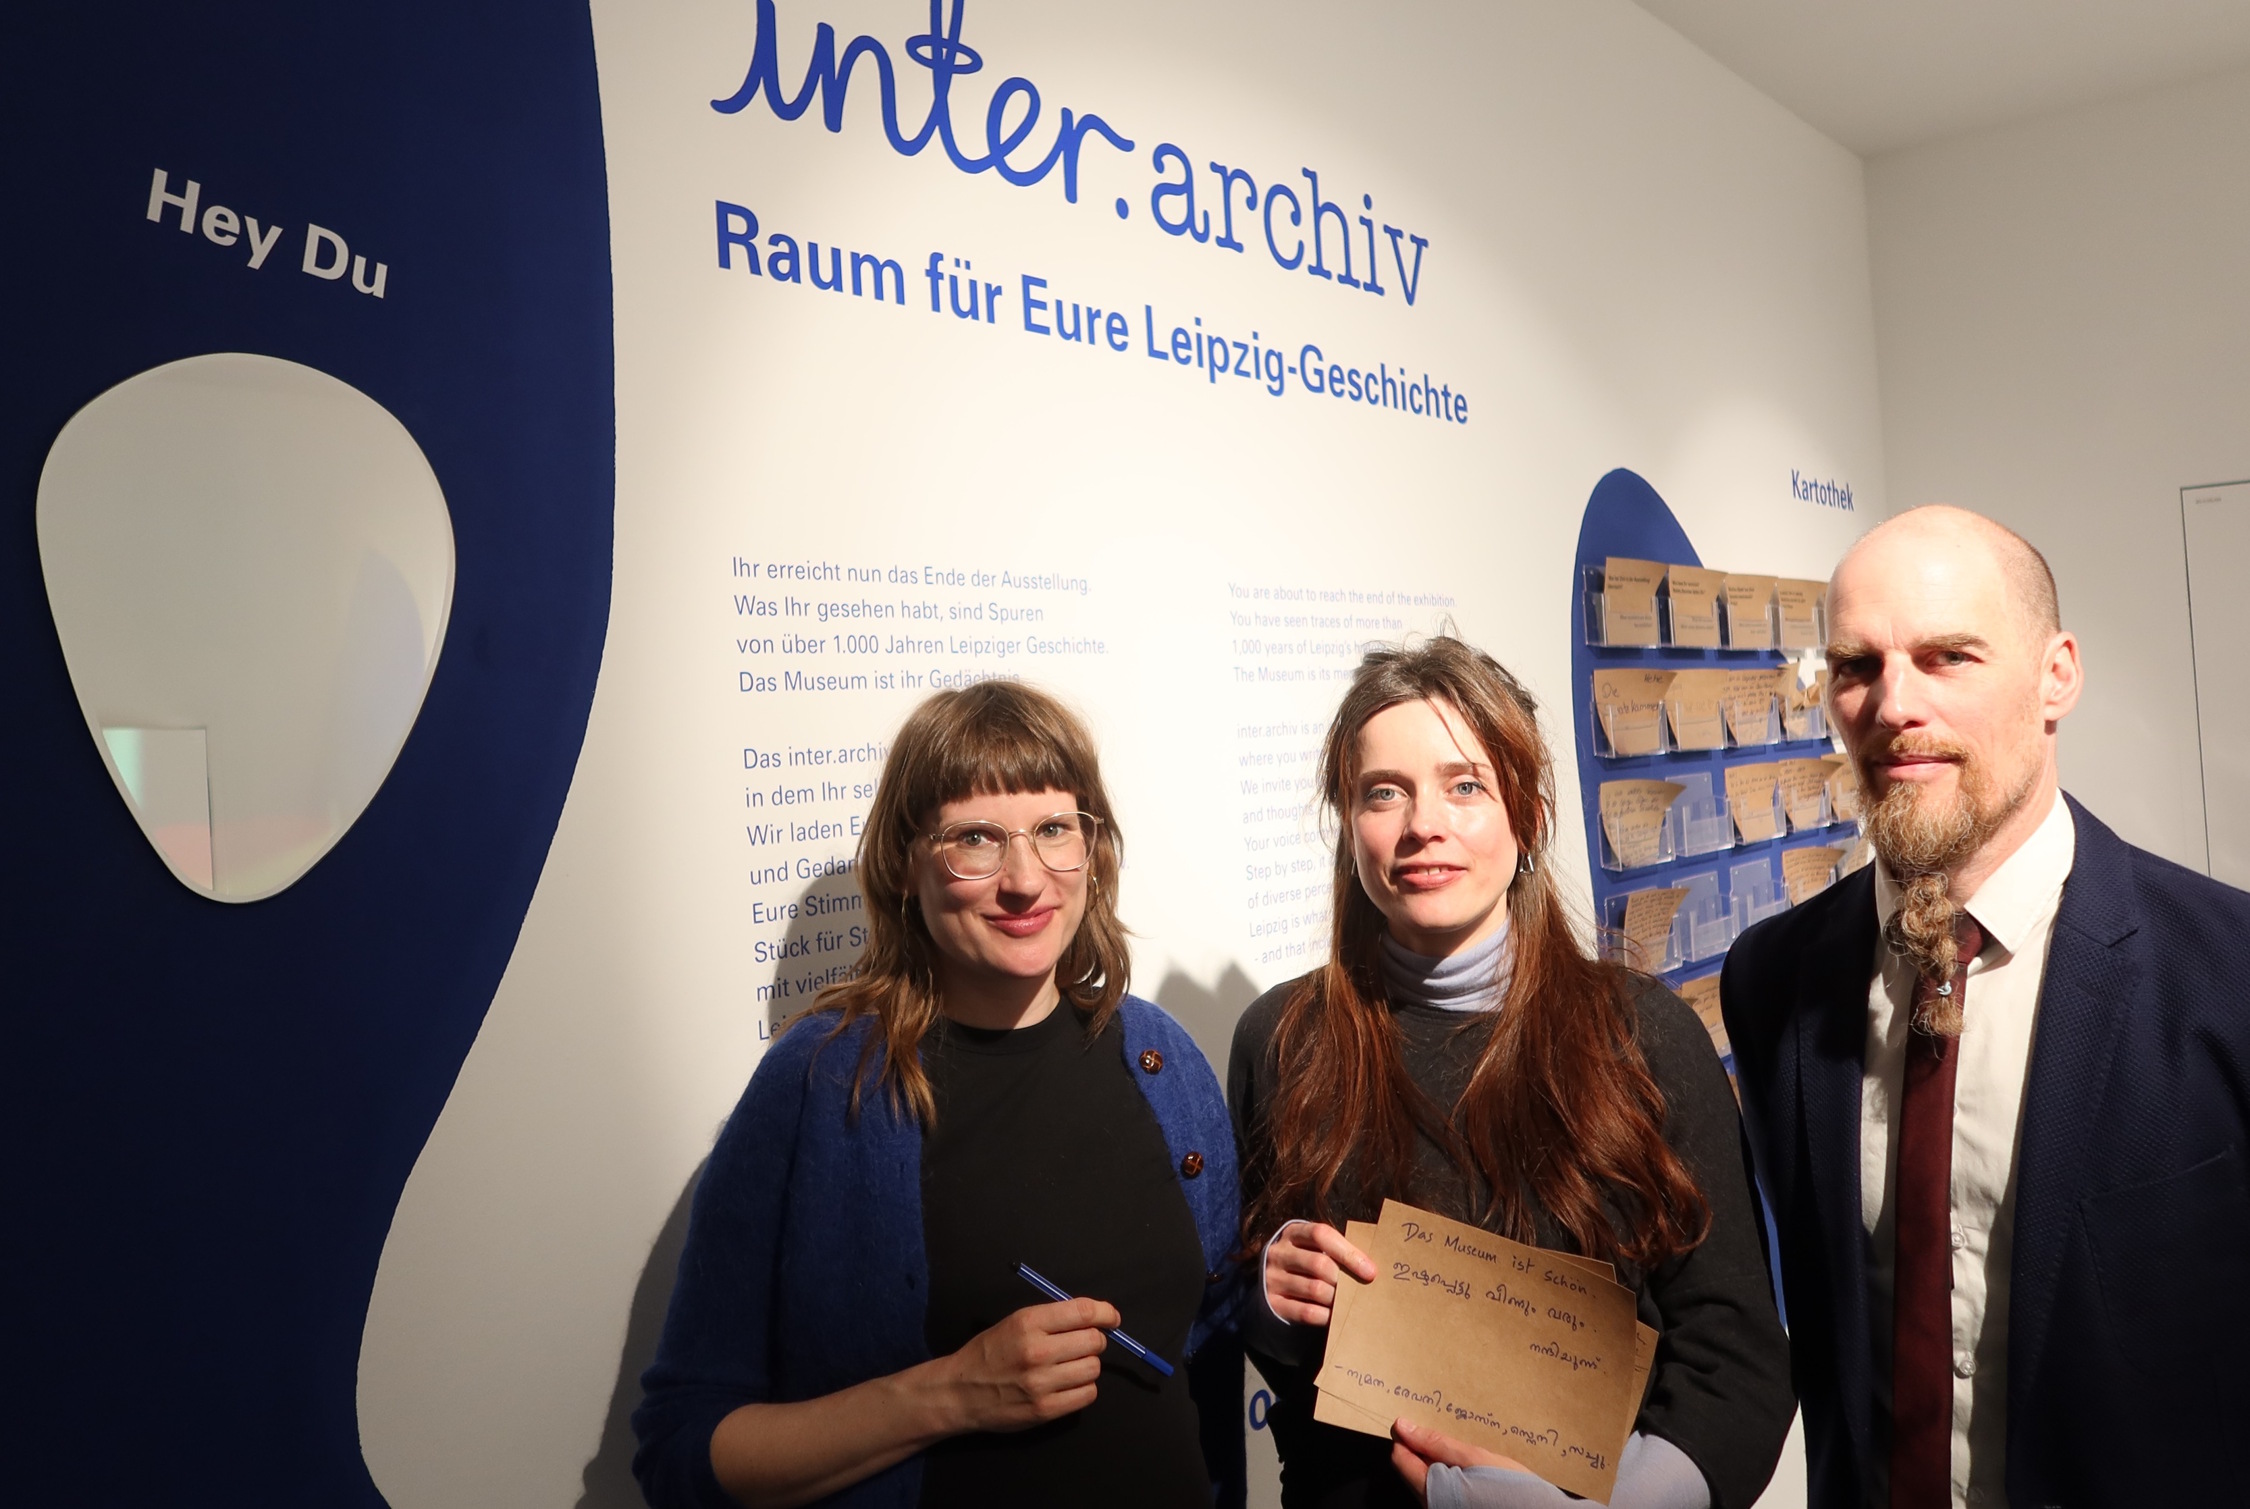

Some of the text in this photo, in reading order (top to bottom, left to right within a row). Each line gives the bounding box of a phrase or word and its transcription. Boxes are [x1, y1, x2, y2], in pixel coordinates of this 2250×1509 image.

[146, 167, 389, 299] Hey Du
[715, 200, 1468, 425] Raum für Eure Leipzig-Geschichte
[1791, 469, 1855, 511] Kartothek
[732, 556, 1093, 595] Ihr erreicht nun das Ende der Ausstellung.
[1228, 582, 1457, 608] You are about to reach the end of the exhibition.
[734, 595, 1044, 625] Was Ihr gesehen habt, sind Spuren
[1229, 611, 1402, 630] You have seen traces of more than
[736, 633, 1109, 658] von über 1.000 Jahren Leipziger Geschichte.
[1232, 639, 1262, 657] 1,000
[1264, 642, 1294, 657] years
[1296, 639, 1307, 655] of
[739, 672, 777, 692] Das
[785, 671, 868, 691] Museum
[874, 670, 895, 689] ist
[901, 670, 923, 689] ihr
[1233, 667, 1255, 683] The
[1258, 667, 1304, 682] Museum
[1307, 667, 1316, 681] is
[1319, 667, 1331, 681] its
[1301, 720, 1310, 735] is
[744, 747, 782, 769] Das
[1239, 752, 1274, 767] where
[1276, 752, 1296, 767] you
[745, 788, 764, 808] in
[771, 784, 814, 807] dem
[822, 781, 846, 801] Ihr
[1240, 777, 1315, 795] We invite you
[1242, 807, 1263, 824] and
[747, 823, 783, 846] Wir
[791, 819, 842, 842] laden
[1244, 836, 1270, 852] Your
[1273, 831, 1301, 848] voice
[750, 862, 788, 885] und
[1246, 864, 1272, 881] Step
[1275, 860, 1288, 878] by
[1248, 892, 1259, 909] of
[1262, 889, 1302, 906] diverse
[752, 902, 798, 924] Eure
[1249, 917, 1289, 938] Leipzig
[1291, 913, 1300, 929] is
[754, 935, 810, 963] Stück
[816, 931, 843, 953] für
[1262, 945, 1282, 964] and
[1285, 941, 1305, 958] that
[757, 977, 790, 1002] mit
[1401, 1222, 1434, 1243] Das
[1444, 1235, 1498, 1264] Museum
[1512, 1255, 1535, 1274] ist
